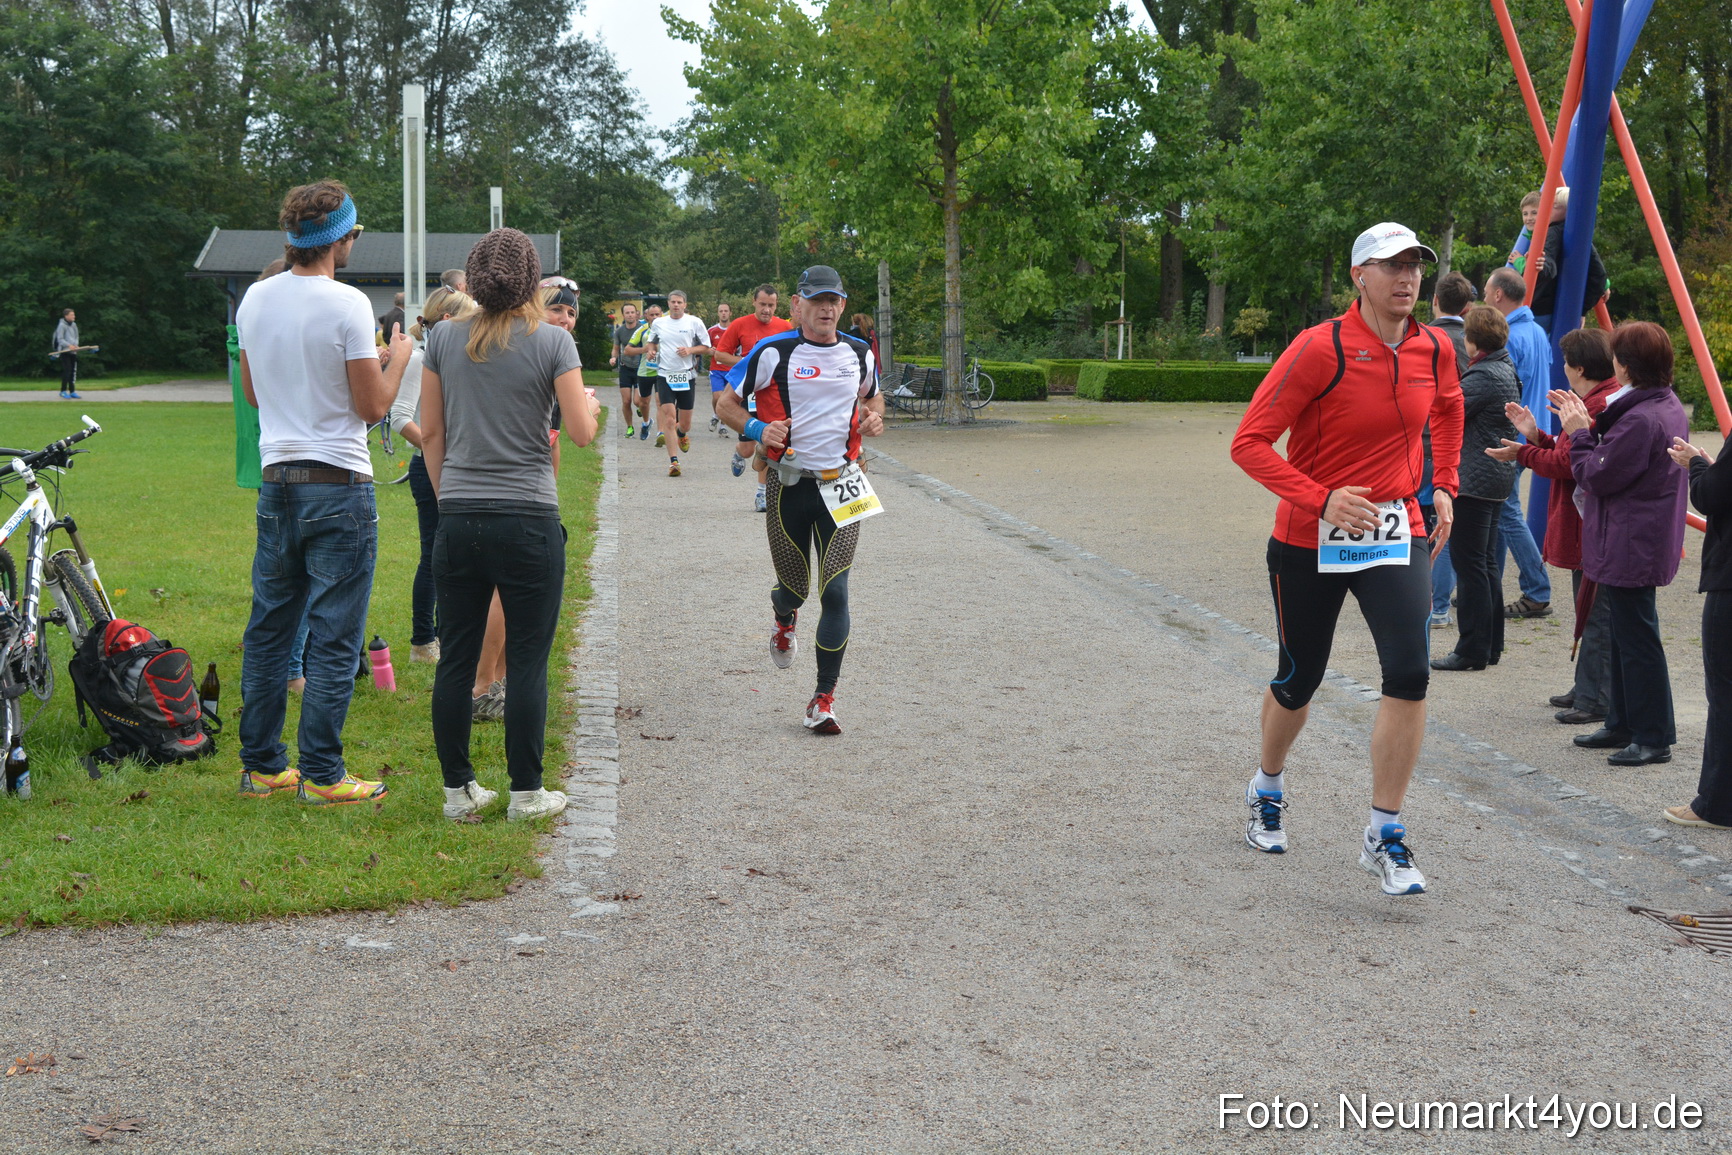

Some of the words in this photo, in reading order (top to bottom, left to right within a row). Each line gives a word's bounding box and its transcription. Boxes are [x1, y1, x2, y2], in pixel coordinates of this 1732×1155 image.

[796, 367, 814, 375] tkn
[668, 374, 687, 383] 2566
[273, 469, 309, 483] PMA
[849, 501, 873, 515] Jürgen
[4, 508, 26, 532] STING
[1339, 549, 1389, 561] Clemens
